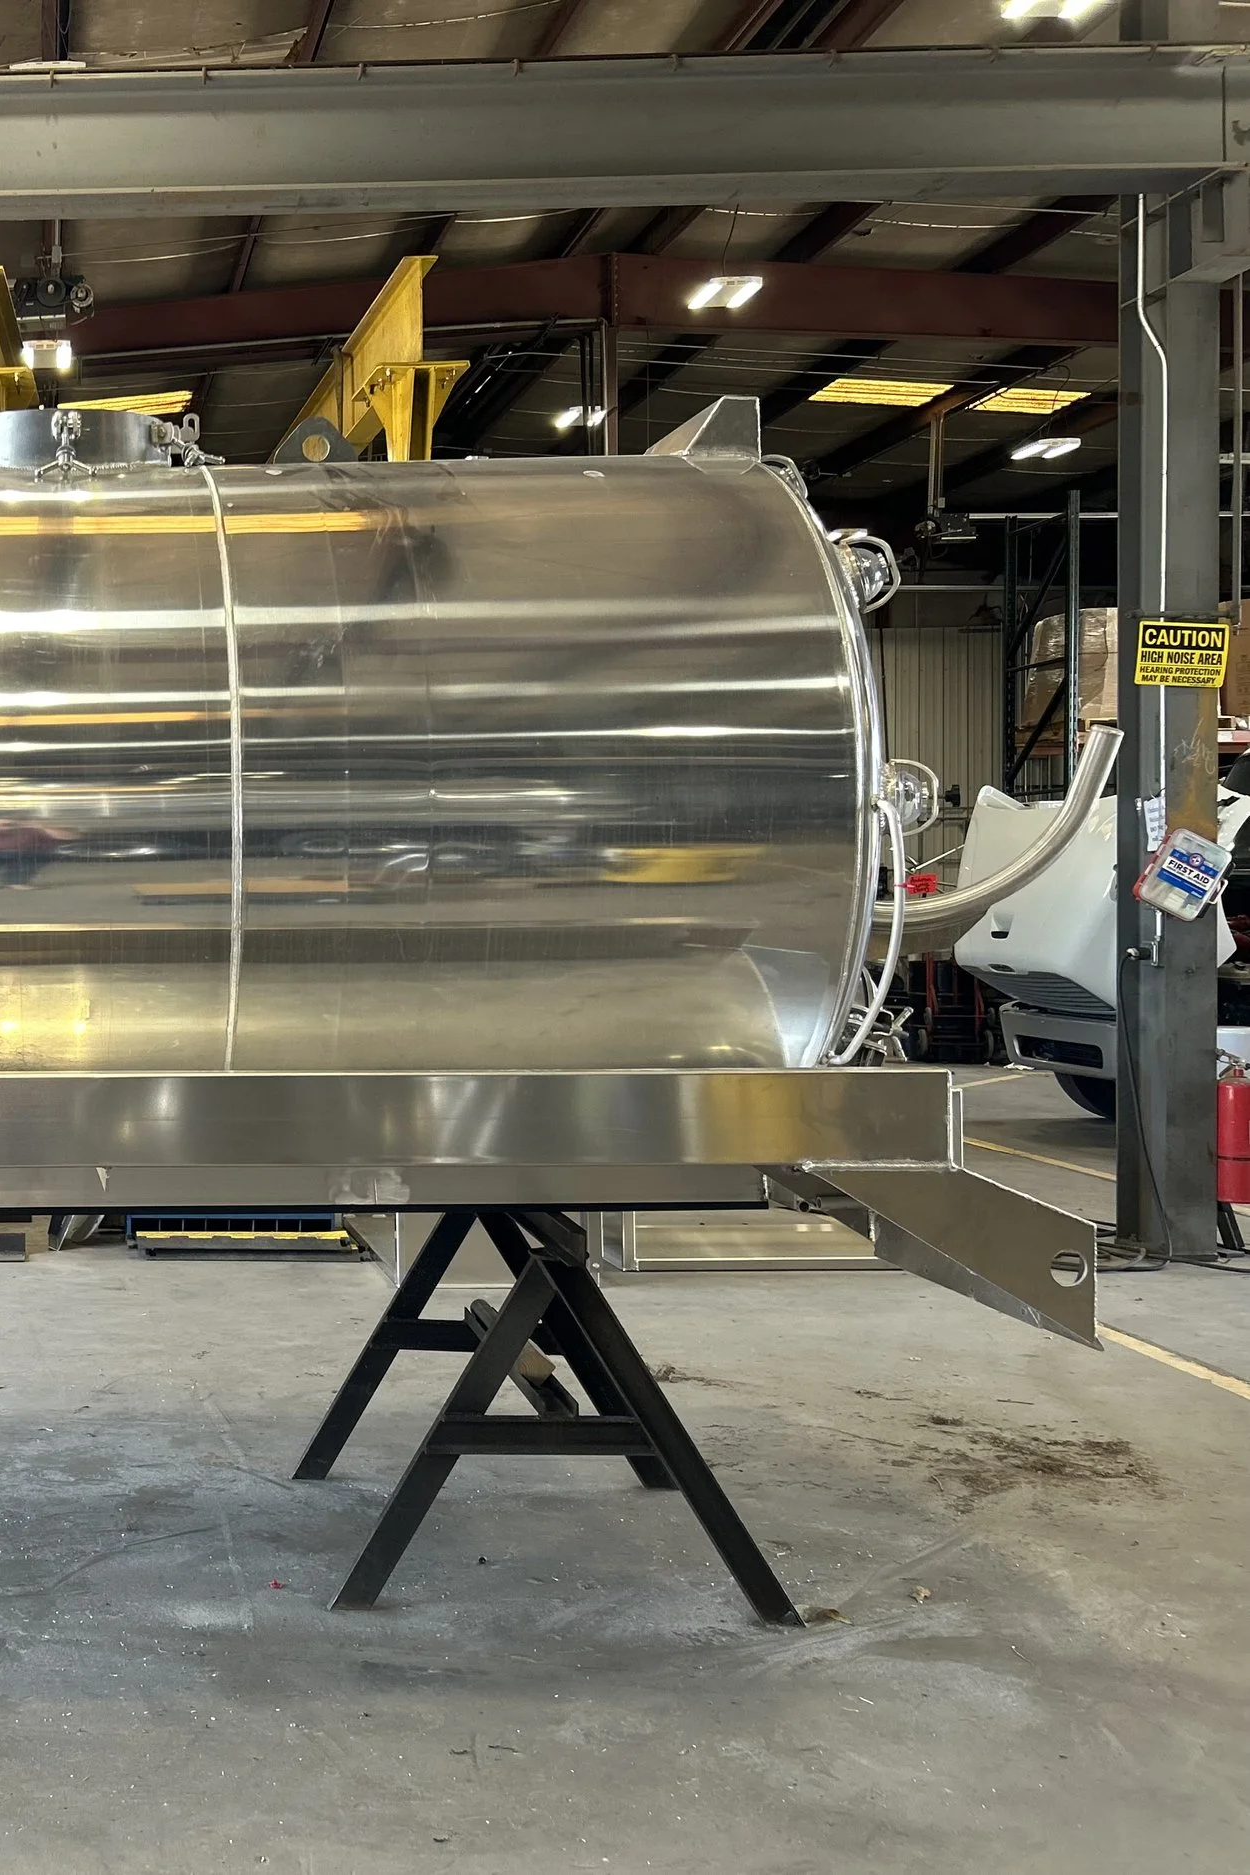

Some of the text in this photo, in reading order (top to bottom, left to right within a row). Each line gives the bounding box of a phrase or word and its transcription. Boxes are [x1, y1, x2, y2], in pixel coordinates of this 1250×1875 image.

[1145, 628, 1223, 648] CAUTION
[1141, 650, 1222, 666] HIGH NOISE AREA
[1140, 666, 1221, 676] HEARING PROTECTION
[1141, 674, 1216, 685] MAY BE NECESSARY
[1168, 859, 1194, 875] FIRST
[1193, 873, 1210, 884] AID
